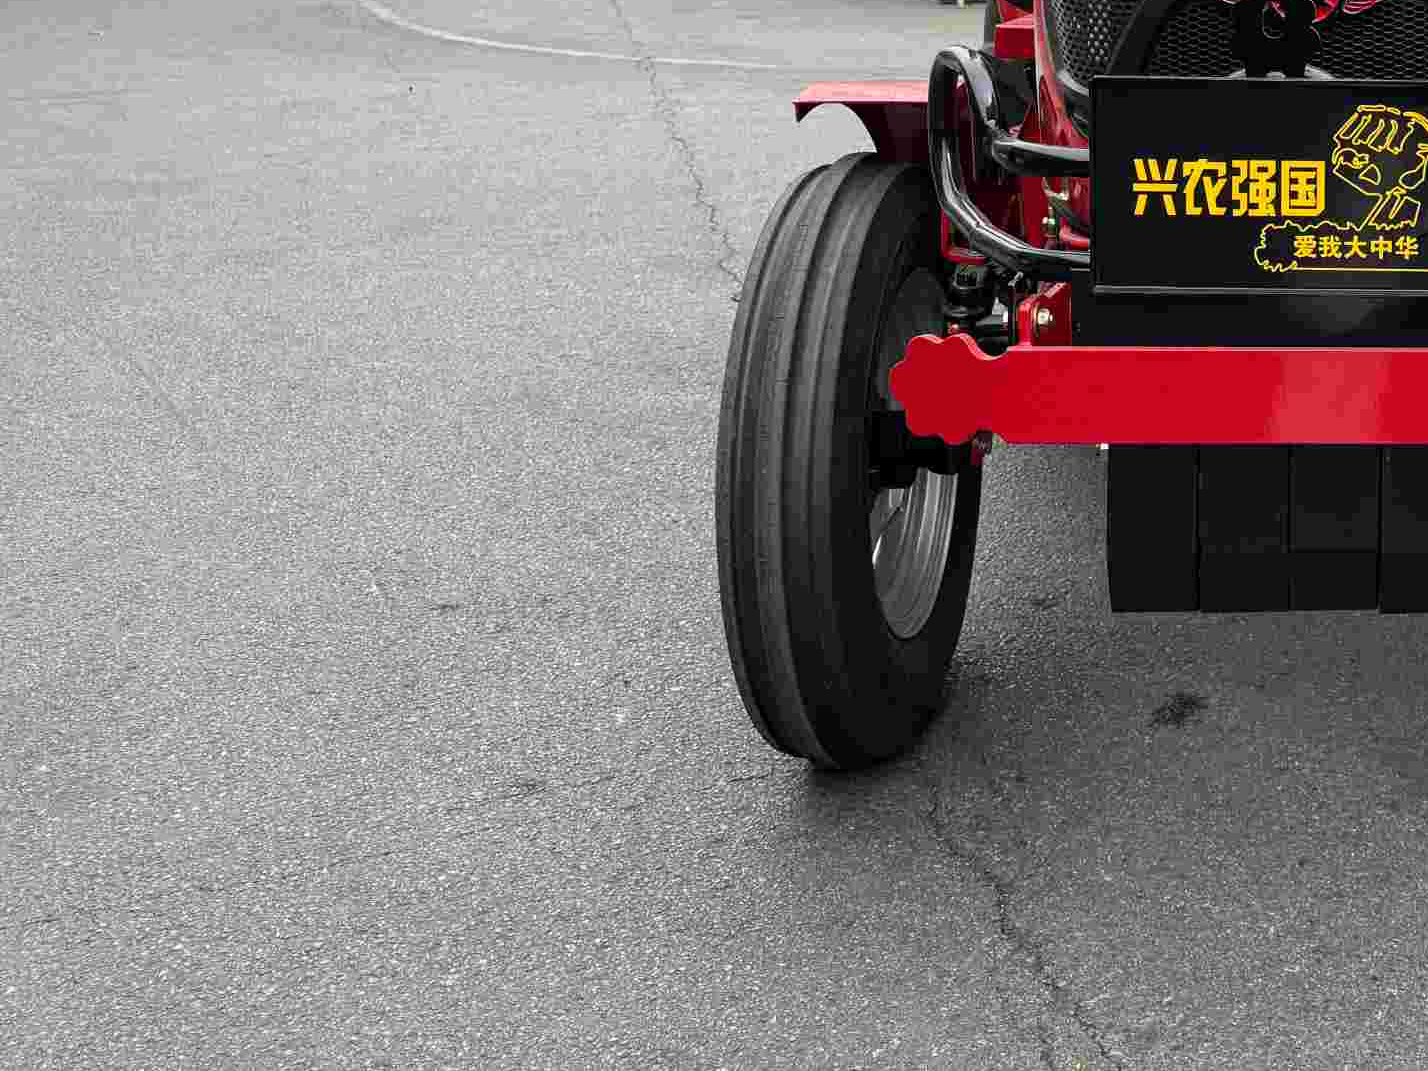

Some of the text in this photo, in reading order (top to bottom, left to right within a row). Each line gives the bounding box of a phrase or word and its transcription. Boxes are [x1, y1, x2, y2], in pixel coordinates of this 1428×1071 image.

[1132, 158, 1326, 217] 兴农强国
[1293, 234, 1419, 260] 爱我大中华
